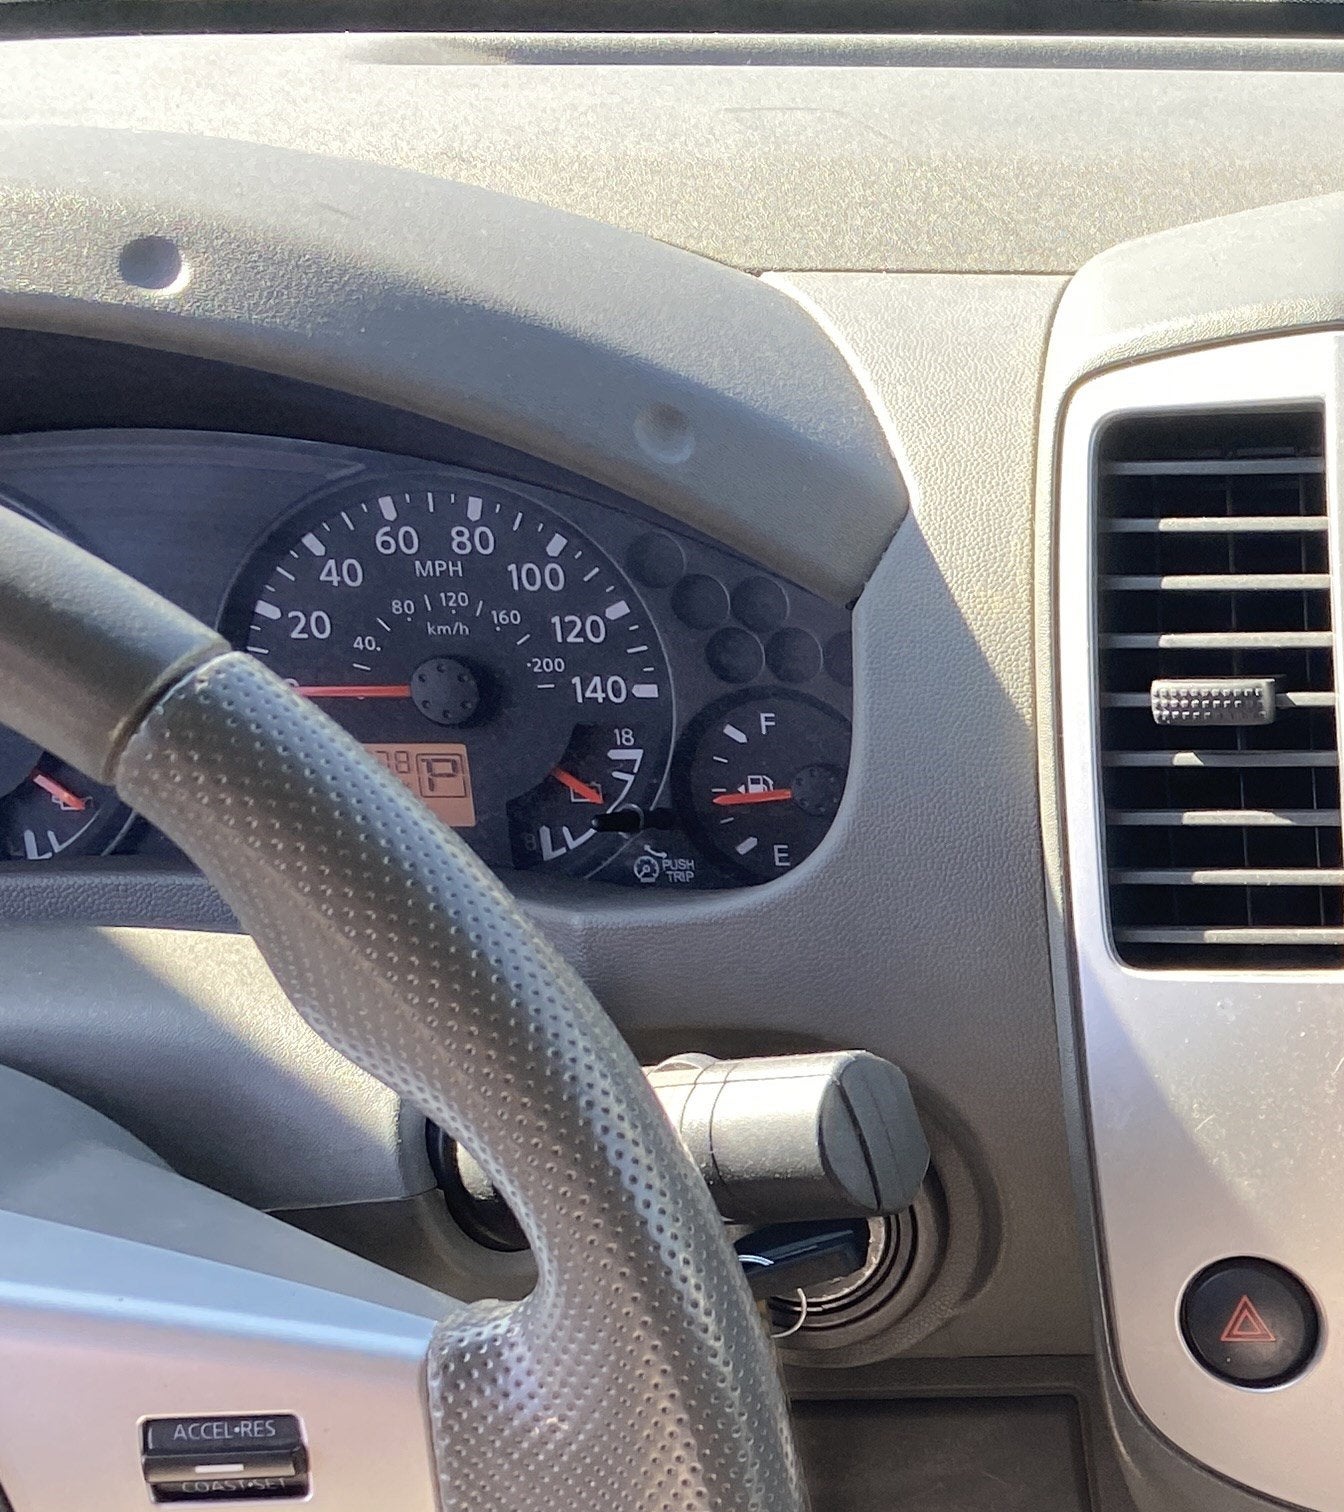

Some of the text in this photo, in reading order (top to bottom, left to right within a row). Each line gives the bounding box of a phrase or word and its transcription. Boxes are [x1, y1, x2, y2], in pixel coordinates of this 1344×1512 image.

[375, 526, 419, 555] 60
[450, 526, 495, 555] 80
[319, 558, 363, 587] 40
[414, 560, 463, 577] MPH
[507, 562, 565, 592] 100
[391, 599, 415, 615] 80
[439, 591, 469, 607] 120
[287, 610, 331, 640] 20
[491, 609, 521, 625] 160
[426, 620, 470, 636] km/h
[550, 614, 606, 644] 120
[353, 635, 377, 651] 40
[532, 657, 565, 672] 200
[571, 675, 627, 703] 140
[760, 712, 776, 735] F
[613, 729, 635, 747] 18
[421, 757, 458, 792] P
[773, 843, 791, 867] E
[662, 859, 695, 872] PUSH
[666, 870, 695, 884] TRIP
